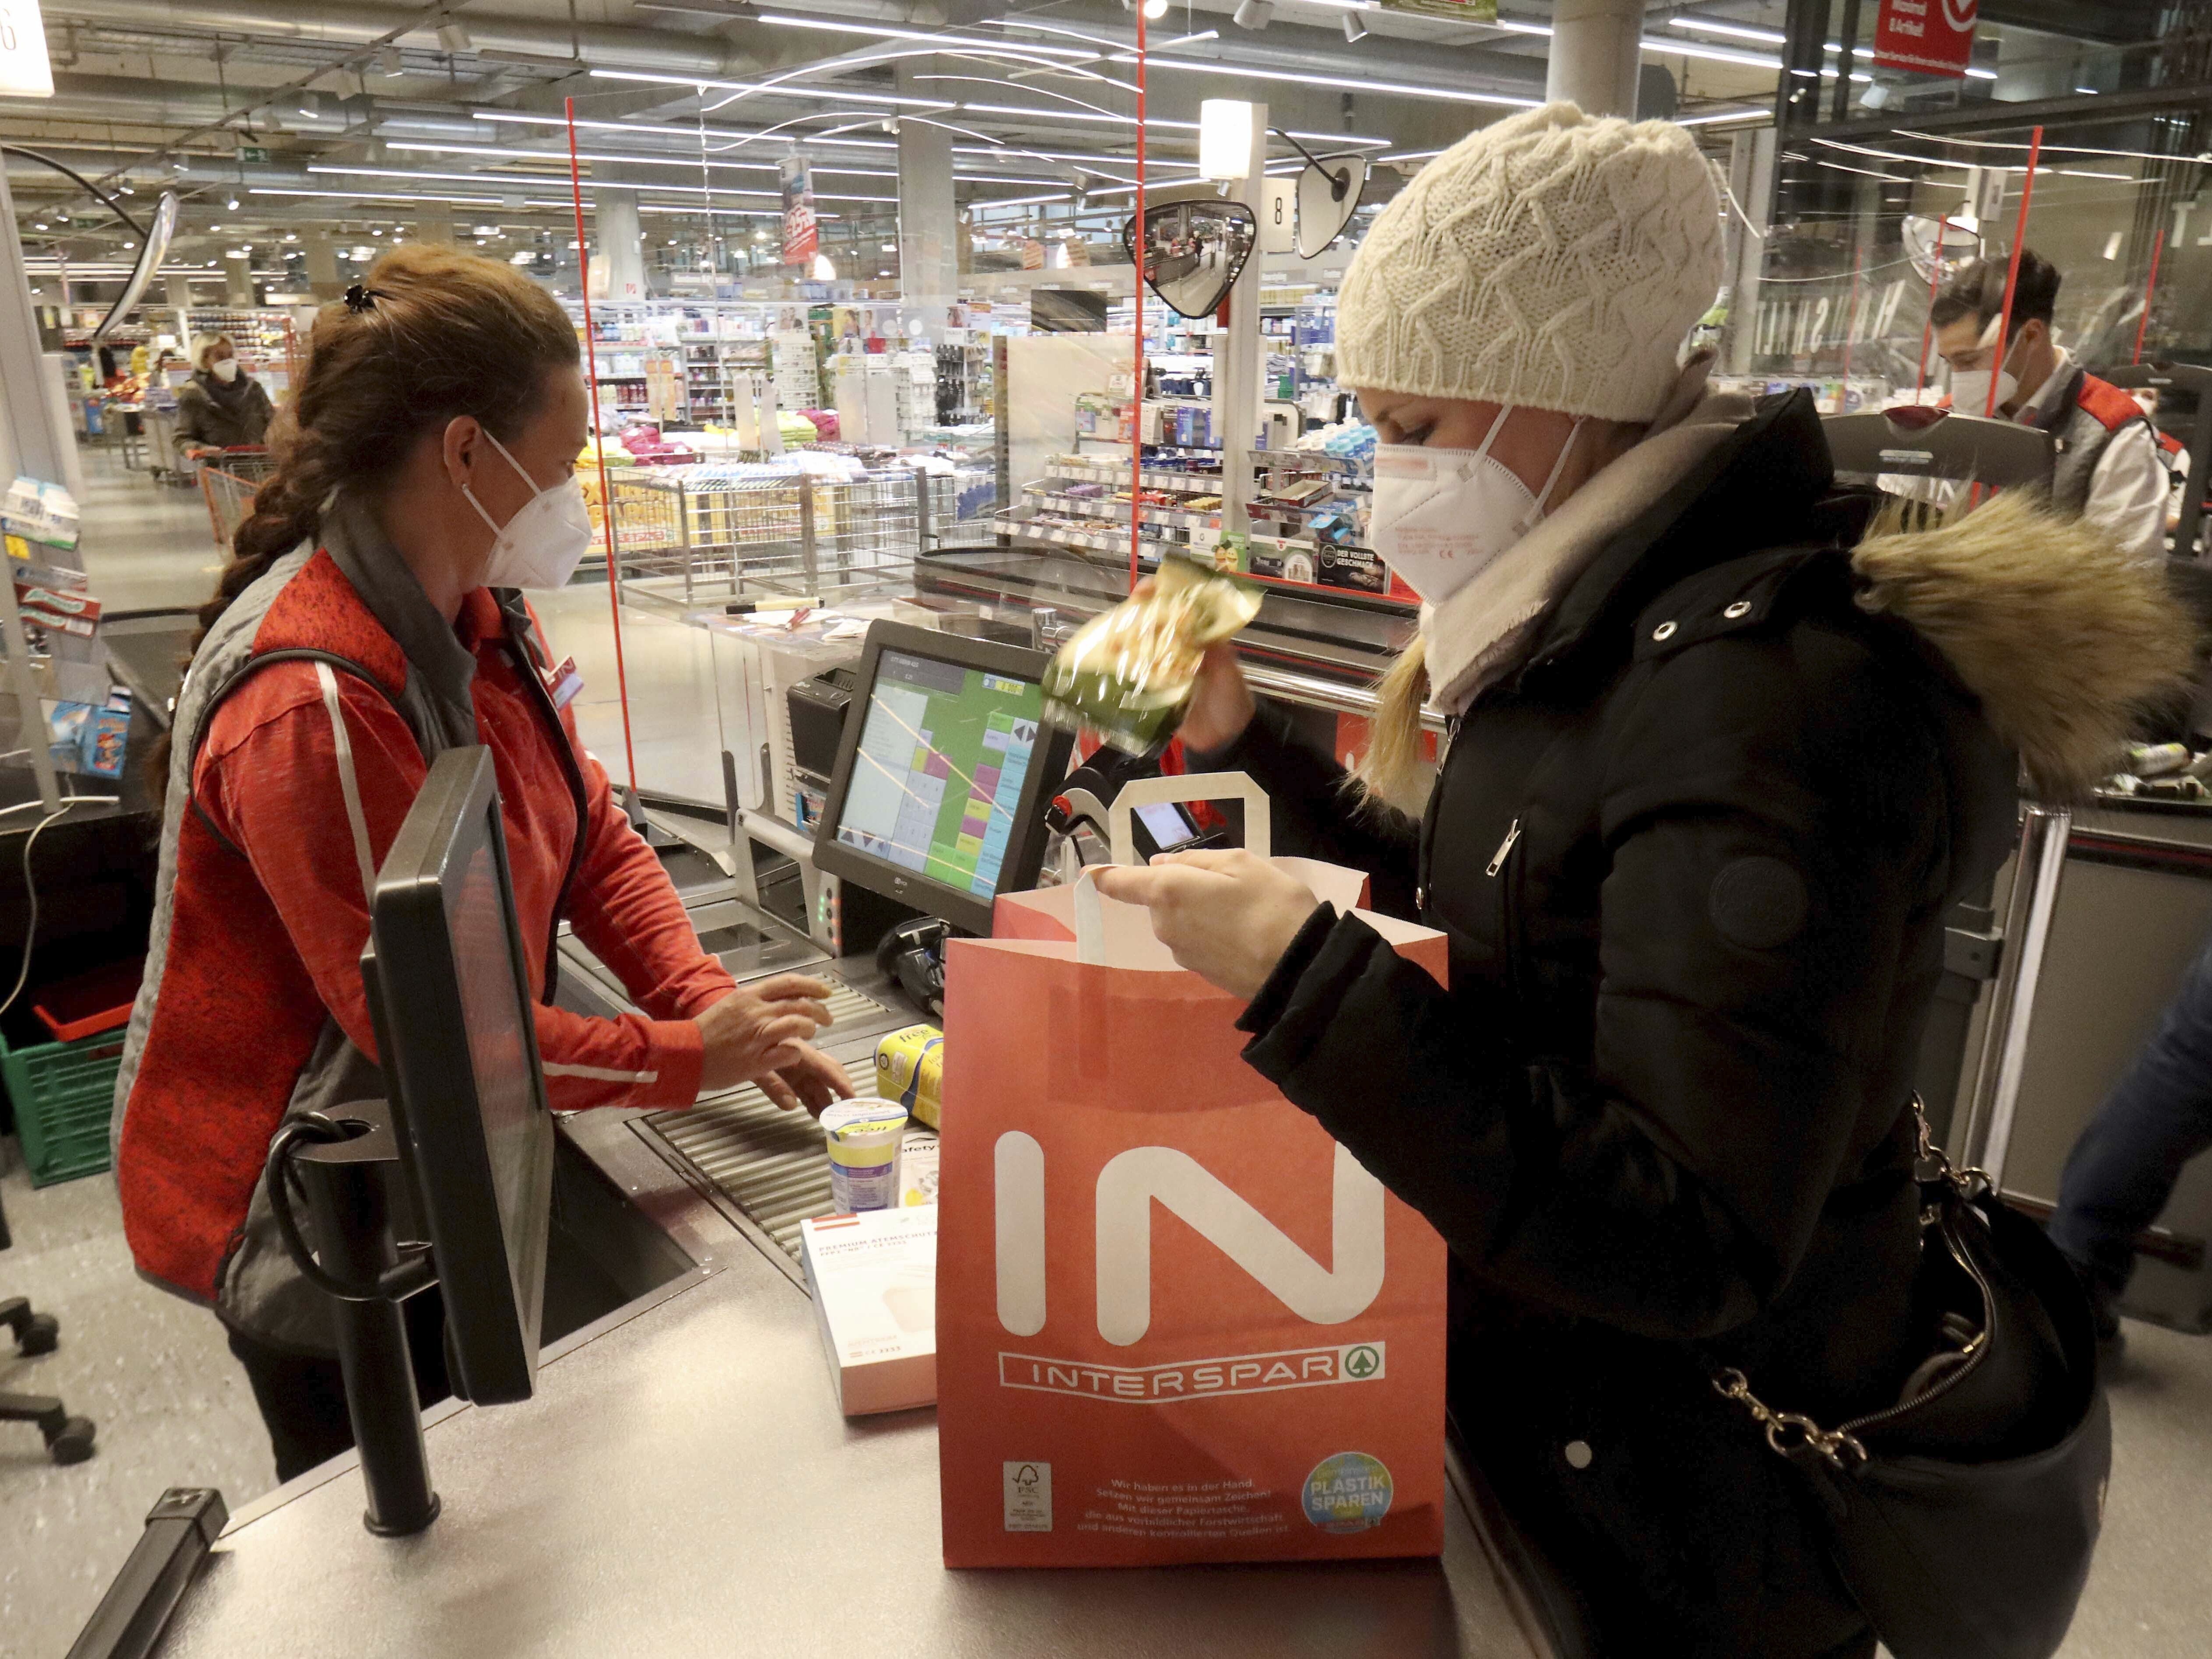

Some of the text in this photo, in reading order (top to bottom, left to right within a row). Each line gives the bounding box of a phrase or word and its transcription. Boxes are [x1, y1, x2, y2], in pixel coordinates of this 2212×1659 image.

[1275, 197, 1282, 225] 8
[1350, 552, 1374, 561] VOLLSTE
[900, 1030, 928, 1043] free
[819, 1240, 867, 1251] PREMIUM
[995, 1131, 1385, 1346] IN
[1032, 1355, 1334, 1397] INTERSPAR
[1111, 1478, 1130, 1489] Wir
[1134, 1481, 1168, 1492] haben
[1188, 1483, 1198, 1491] in
[1201, 1482, 1219, 1491] der
[1311, 1475, 1385, 1496] PLASTIK
[1097, 1487, 1132, 1500] Setzen
[1157, 1494, 1221, 1504] gemeinsam
[1312, 1491, 1383, 1511] SPAREN
[1140, 1505, 1174, 1514] dieser
